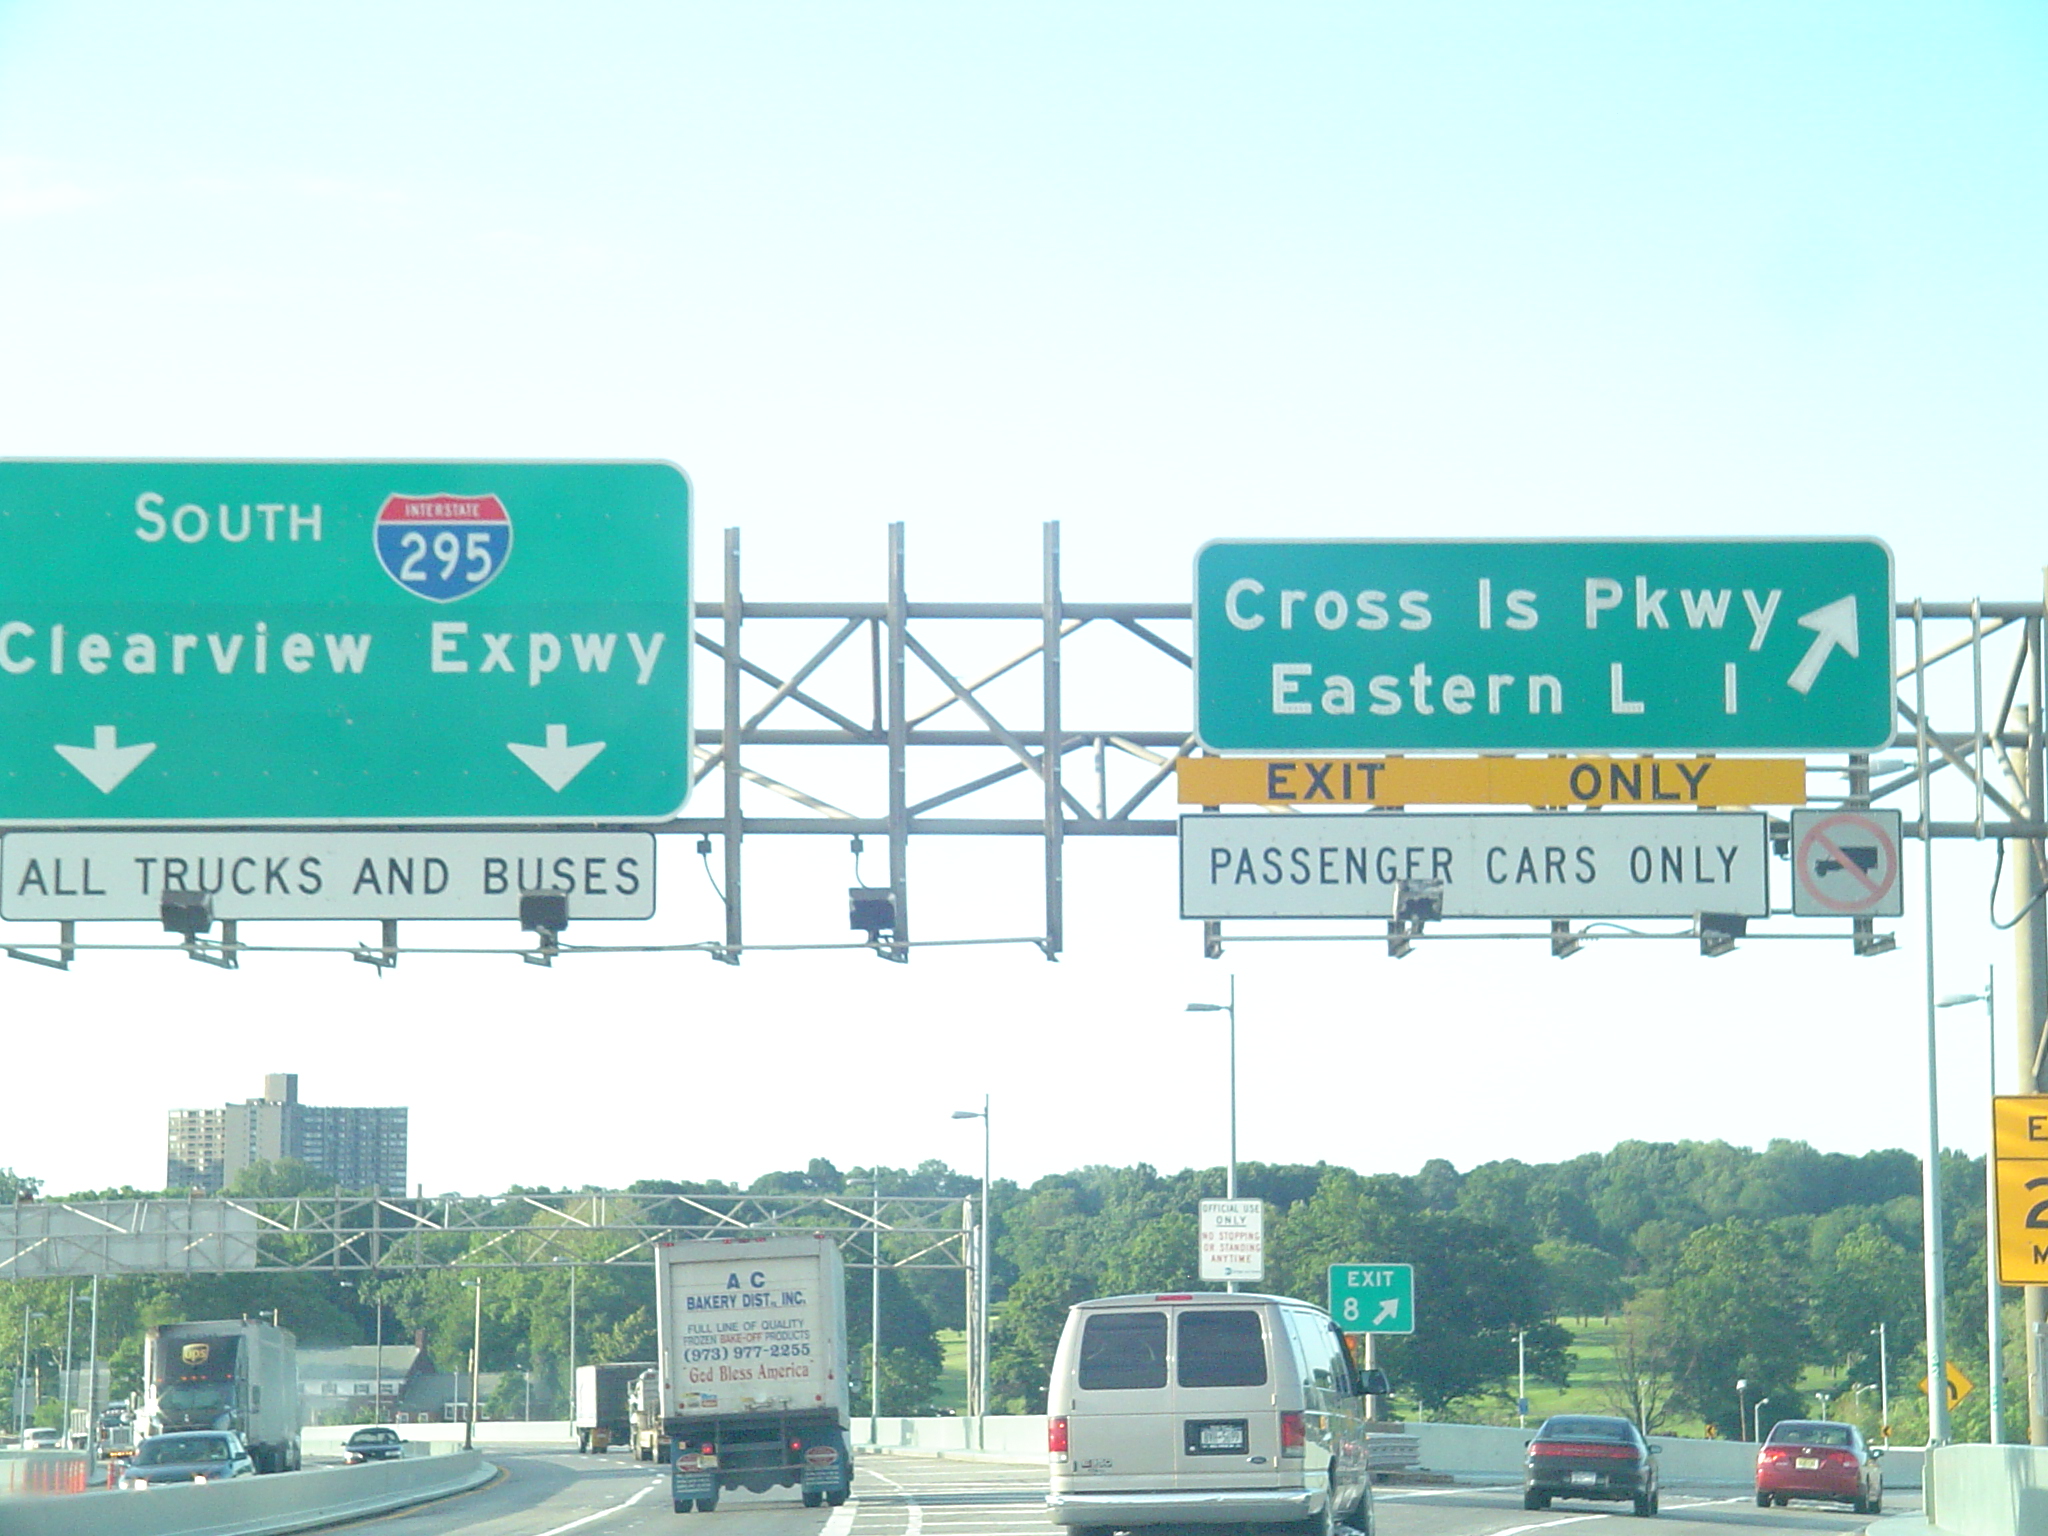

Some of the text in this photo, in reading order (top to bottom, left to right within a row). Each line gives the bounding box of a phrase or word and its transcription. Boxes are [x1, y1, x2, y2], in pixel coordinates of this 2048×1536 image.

[135, 492, 324, 543] SOUTH
[405, 503, 479, 517] INTERSTATE
[400, 531, 492, 582] 295
[1224, 575, 1783, 652] Cross Is Pkwy
[0, 620, 666, 686] Clearview Expwy
[1272, 663, 1737, 715] Eastern L I
[1267, 763, 1712, 801] EXIT ONLY
[1210, 845, 1739, 885] PASSENGER CARS ONLY
[18, 856, 641, 896] ALL TRUCKS AND BUSES
[1202, 1204, 1260, 1213] OFFICIAL USE
[1216, 1215, 1246, 1225] ONLY
[1202, 1231, 1260, 1241] NO STOPPING
[1203, 1243, 1260, 1252] OR STANDING
[1210, 1254, 1251, 1263] ANYTIME
[726, 1271, 766, 1290] A C
[1347, 1271, 1395, 1287] EXIT
[686, 1294, 738, 1311] BAKERY
[781, 1290, 807, 1306] INC.
[1343, 1297, 1360, 1321] 8
[687, 1318, 805, 1334] FULL LINE OF QUALITY
[683, 1329, 810, 1346] FROZEN BAKE-OFF PRODUCTS
[684, 1343, 811, 1363] (973) 977-2255
[719, 1365, 754, 1382] Bless
